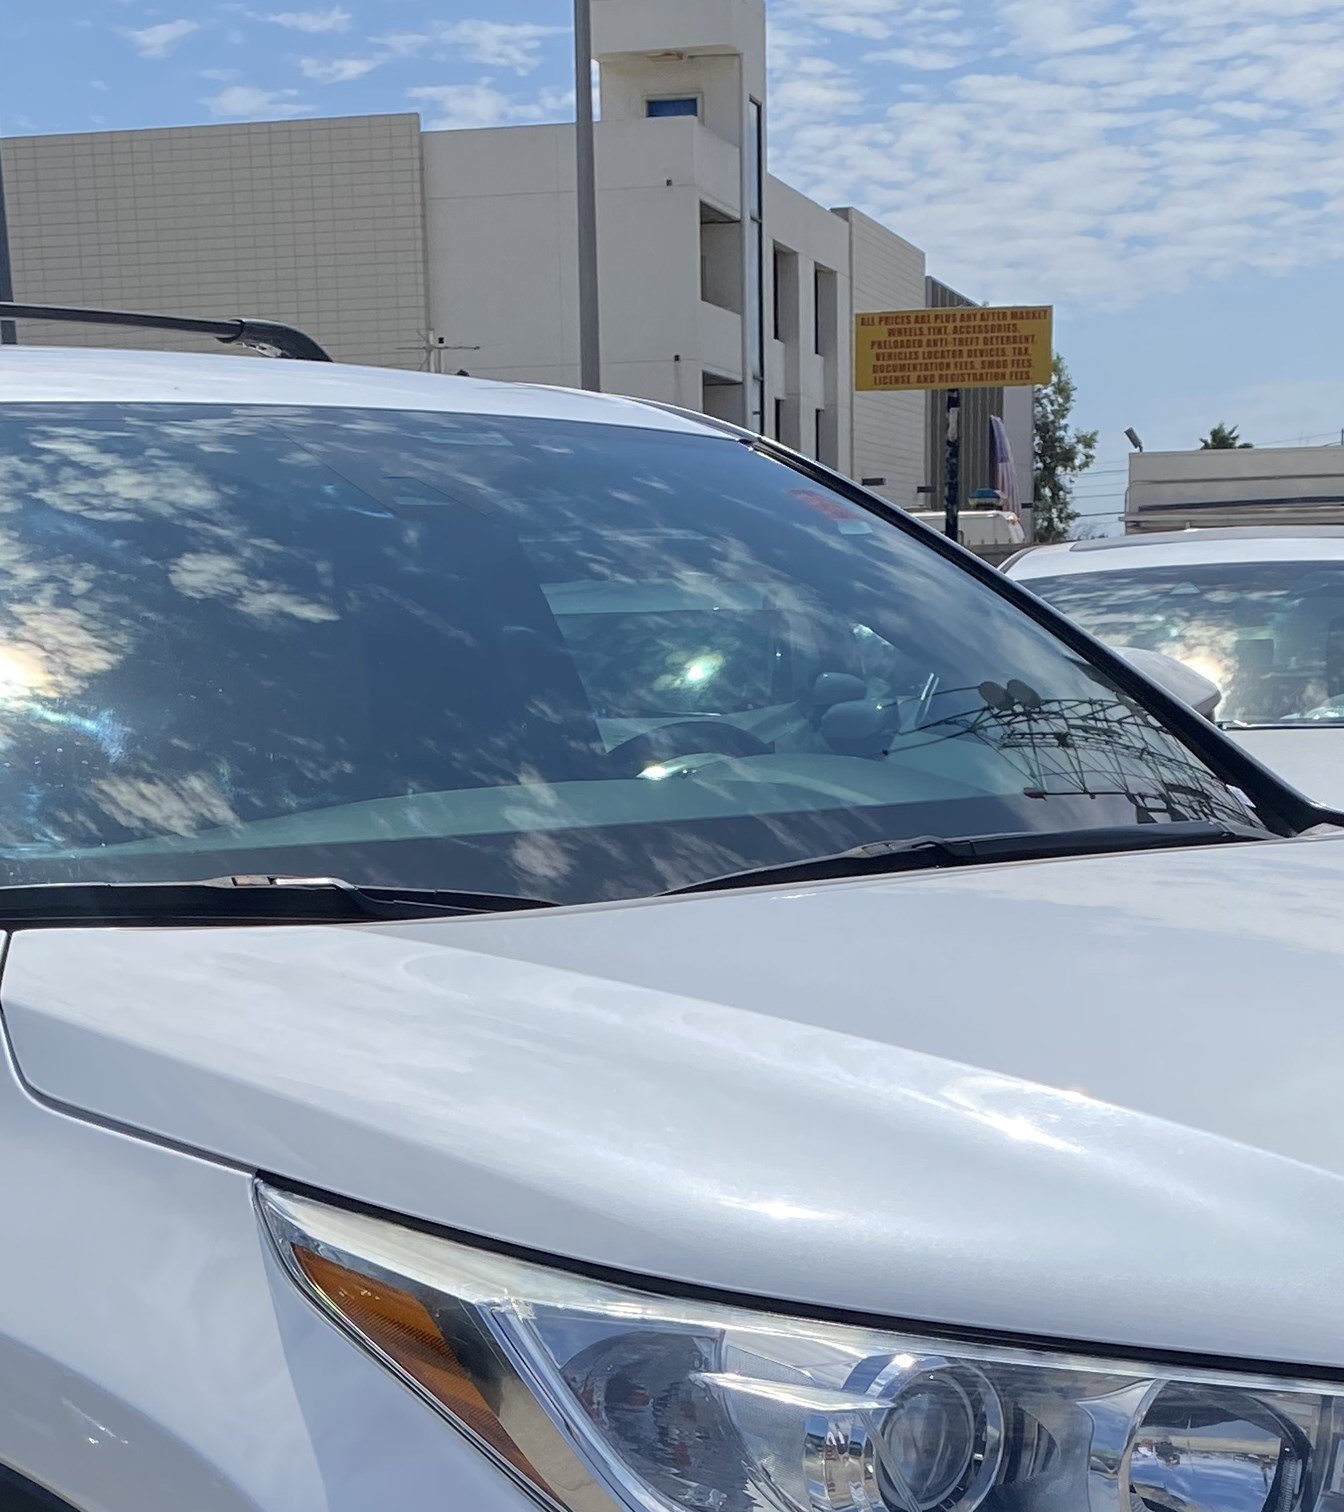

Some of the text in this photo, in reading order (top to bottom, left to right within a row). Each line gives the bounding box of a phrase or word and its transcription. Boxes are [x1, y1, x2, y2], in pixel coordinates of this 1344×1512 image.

[878, 314, 912, 326] PRICES
[934, 312, 956, 324] PLUS
[959, 311, 977, 323] ANY
[980, 310, 1008, 322] AFTER
[1010, 309, 1048, 321] MARKET
[875, 350, 919, 362] VEHICLES
[922, 349, 965, 360] LOCATOR
[872, 361, 951, 374] DOCUMENTATION
[916, 373, 936, 385] AND
[938, 371, 1006, 384] REGISTRATION
